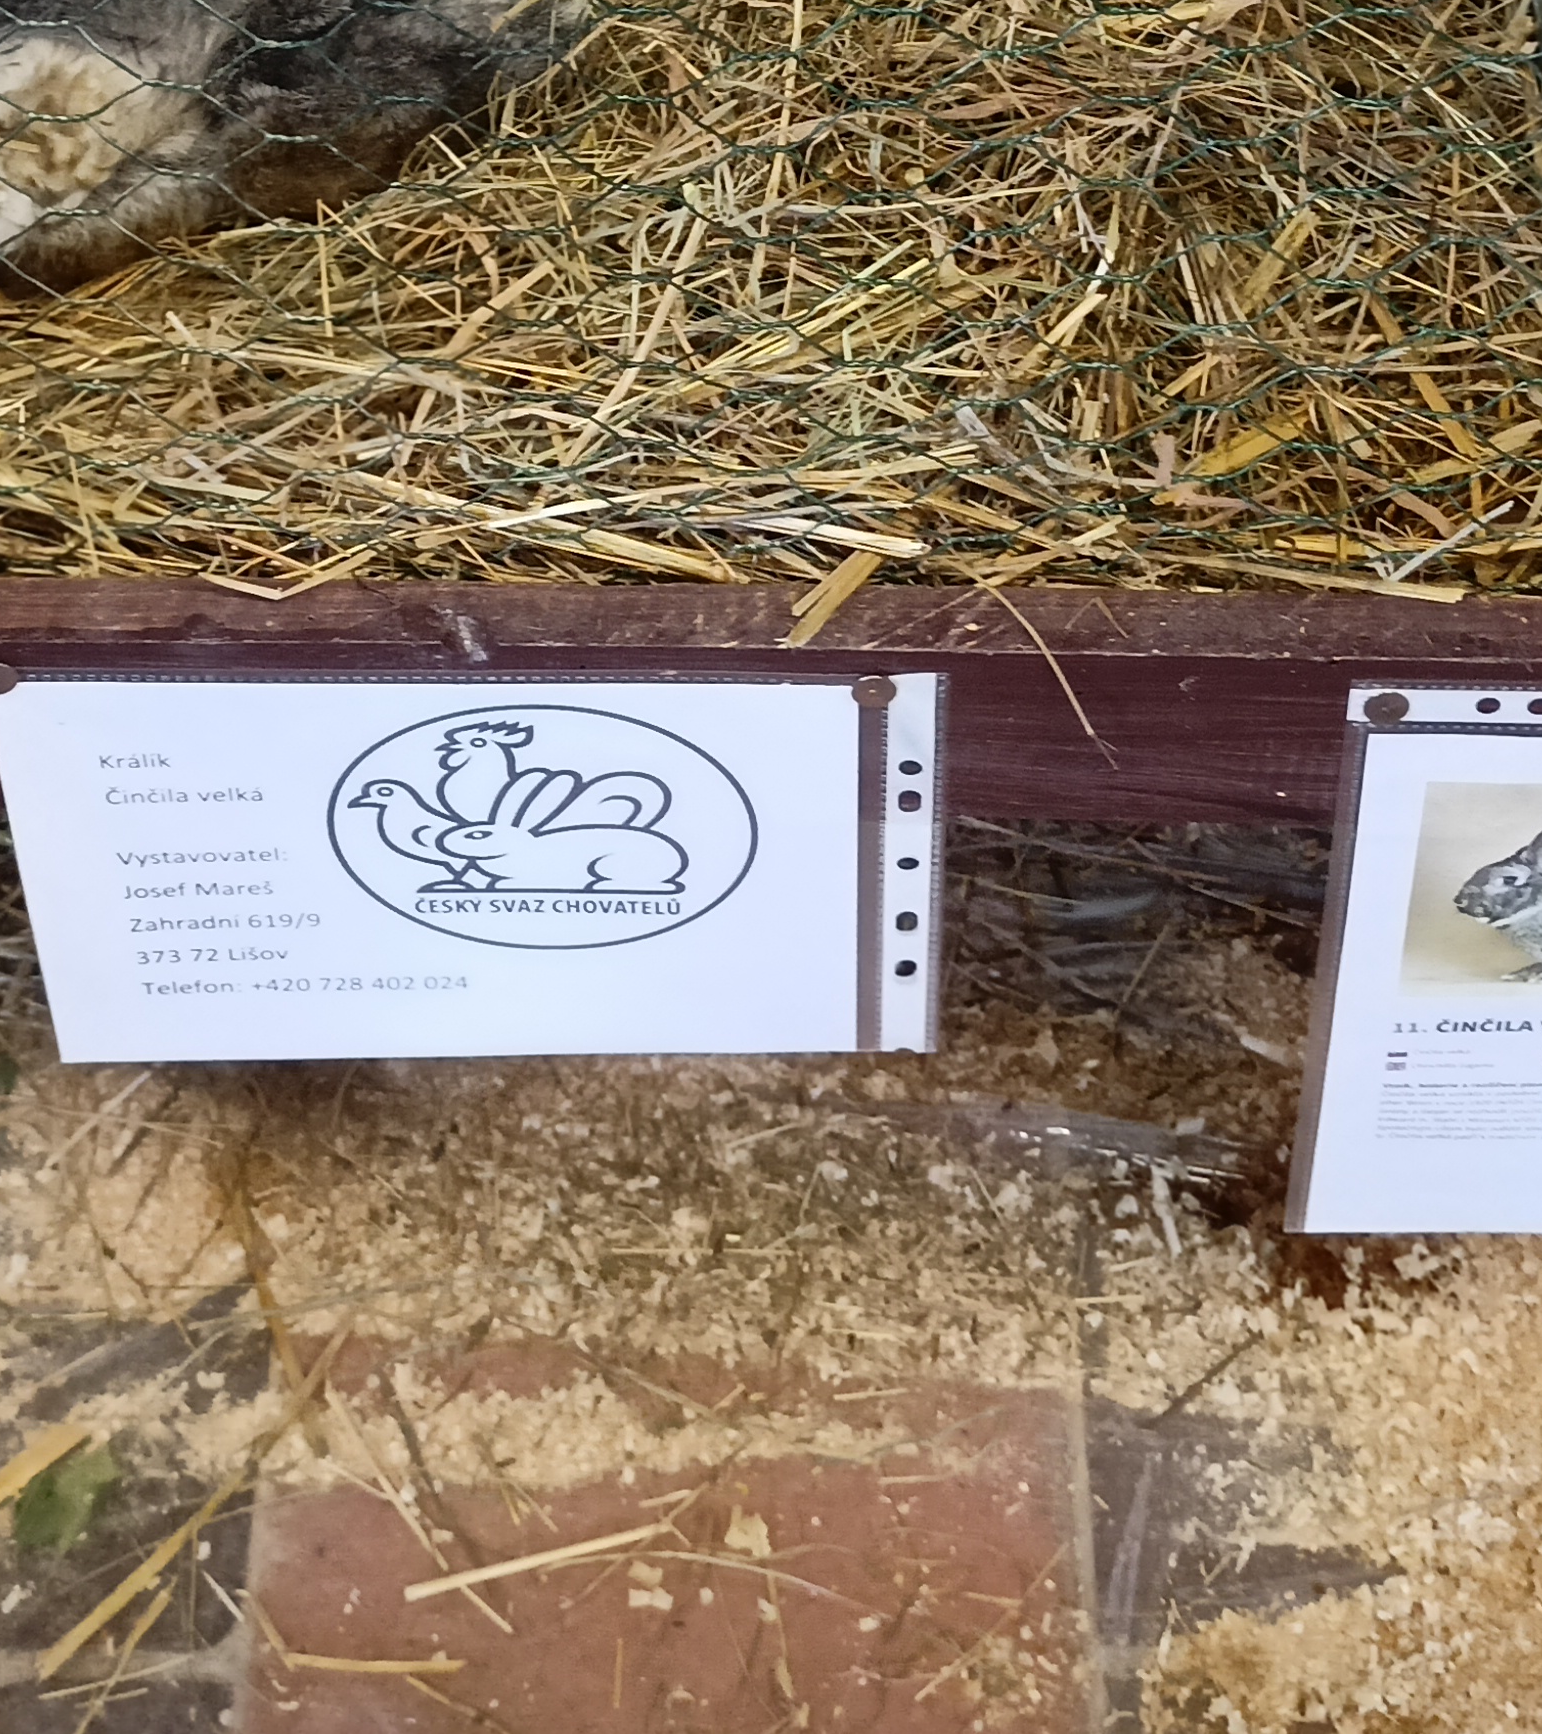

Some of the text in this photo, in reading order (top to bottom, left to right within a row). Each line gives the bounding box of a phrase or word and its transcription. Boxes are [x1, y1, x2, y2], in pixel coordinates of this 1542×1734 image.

[99, 753, 171, 769] Králík
[105, 786, 264, 805] Činčila velká
[116, 847, 288, 868] Vystavovatel:
[124, 880, 274, 900] Josef Mareš
[414, 897, 682, 916] ČESKÝ SVAZ CHOVATELŮ
[129, 912, 321, 933] Zahradní 619/9
[137, 946, 289, 965] 373 72 Lišov
[141, 975, 469, 996] Telefon: +420 728 402 024
[1393, 1022, 1428, 1034] 11.
[1435, 1018, 1534, 1033] ČINČILA
